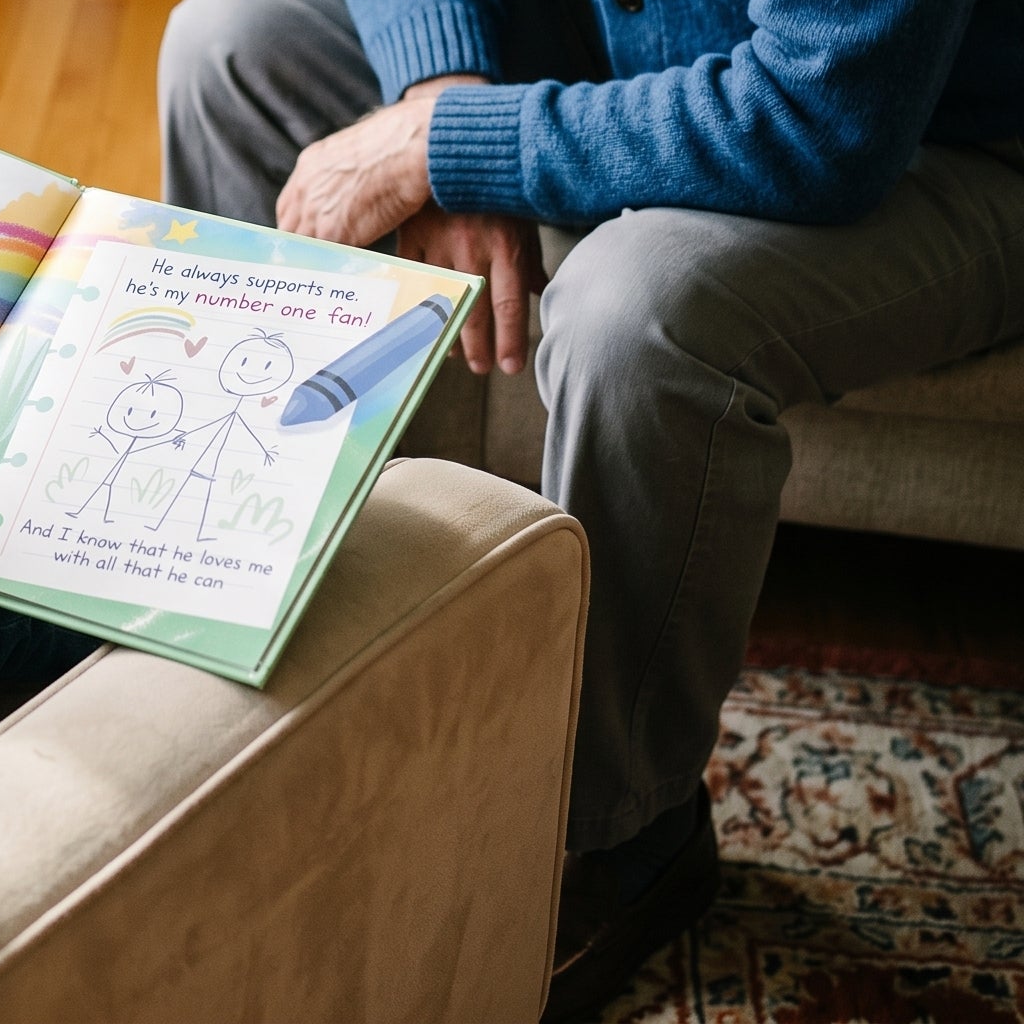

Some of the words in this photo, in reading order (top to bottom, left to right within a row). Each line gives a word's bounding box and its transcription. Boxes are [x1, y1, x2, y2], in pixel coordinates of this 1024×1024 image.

[126, 278, 158, 296] he's
[164, 289, 190, 305] my
[195, 290, 274, 314] number
[281, 304, 316, 320] one
[328, 306, 372, 328] fan!
[151, 258, 173, 276] He
[181, 264, 239, 288] always
[246, 276, 323, 296] supports
[330, 288, 358, 302] me.
[20, 519, 54, 538] And
[58, 527, 72, 541] I
[76, 530, 122, 550] know
[129, 539, 167, 558] that
[172, 546, 192, 562] he
[200, 550, 241, 570] loves
[248, 562, 273, 576] me
[54, 550, 89, 567] with
[96, 556, 118, 572] all
[124, 560, 162, 578] that
[168, 566, 188, 584] he
[194, 575, 223, 589] can
